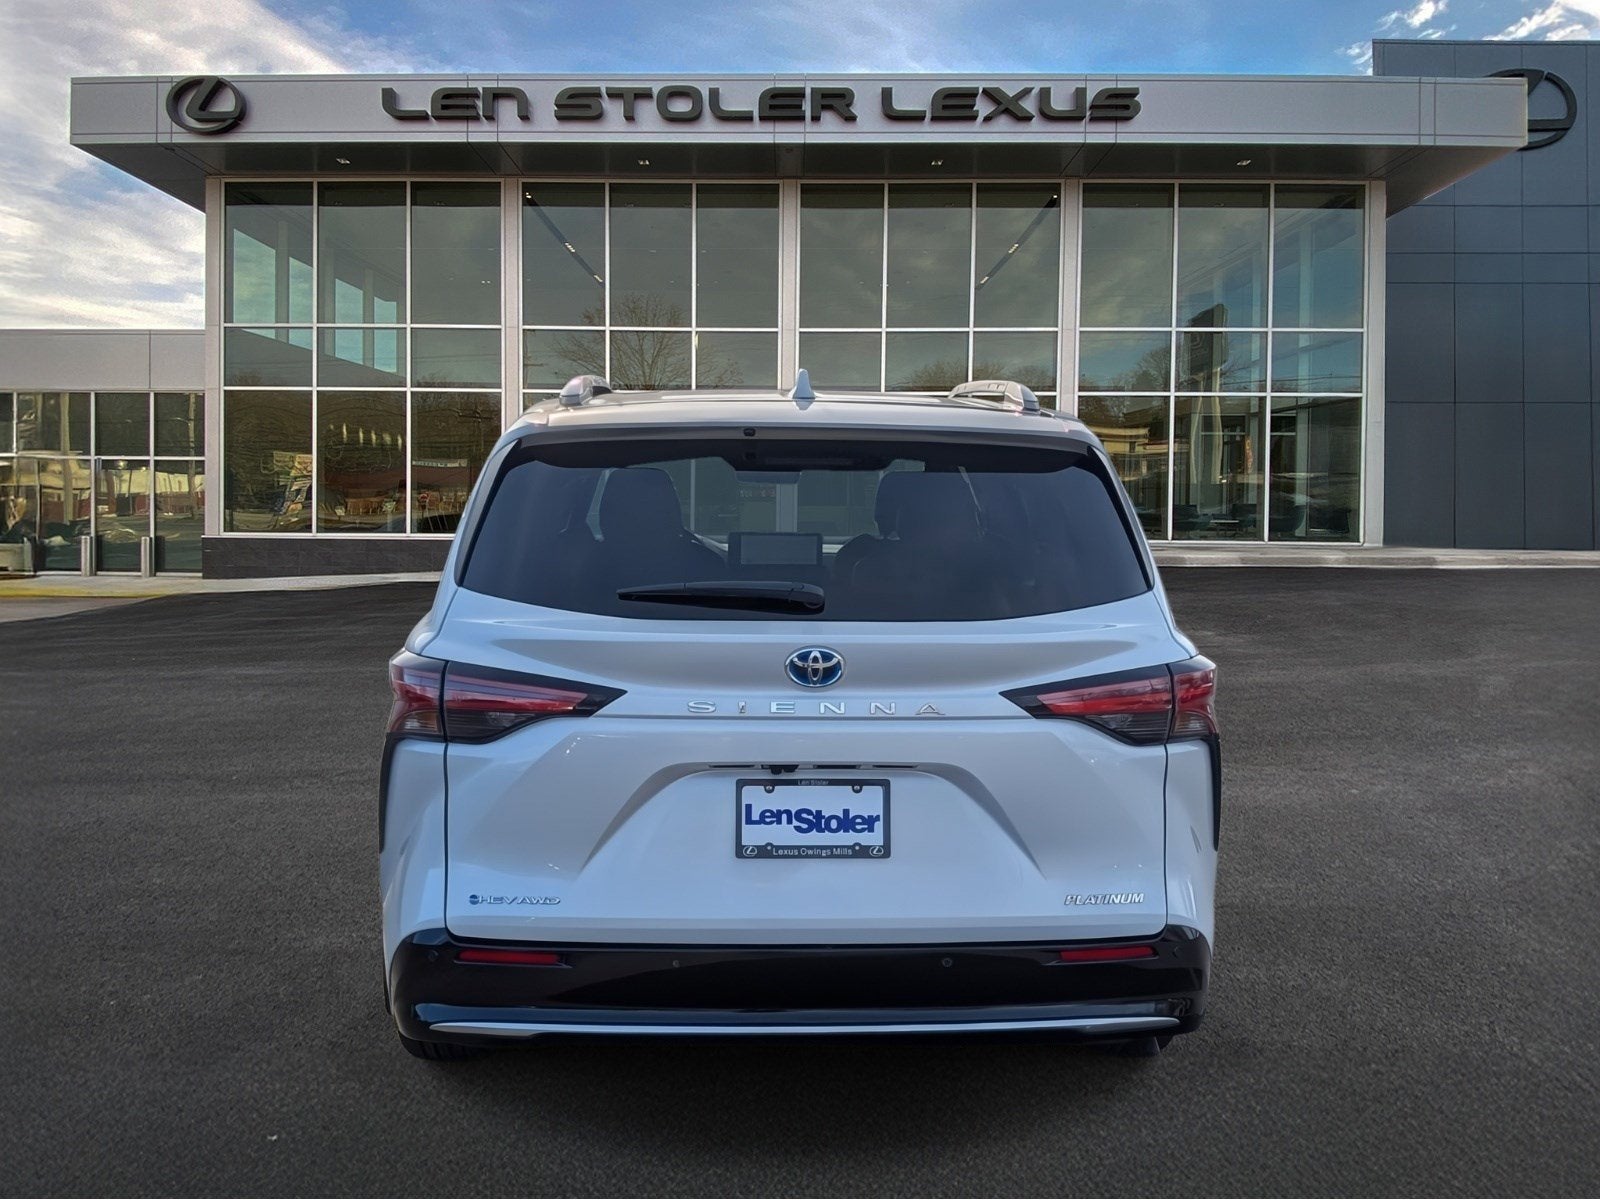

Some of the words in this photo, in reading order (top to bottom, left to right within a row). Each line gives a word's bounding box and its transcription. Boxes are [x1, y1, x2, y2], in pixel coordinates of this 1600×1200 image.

[381, 86, 530, 122] LEN
[553, 86, 858, 122] STOLER
[881, 86, 1143, 122] LEXUS
[687, 701, 946, 715] SIENNA
[772, 847, 799, 856] Lexus
[800, 847, 831, 857] Owings
[832, 847, 853, 856] Mills
[1064, 893, 1145, 906] PLATINUM
